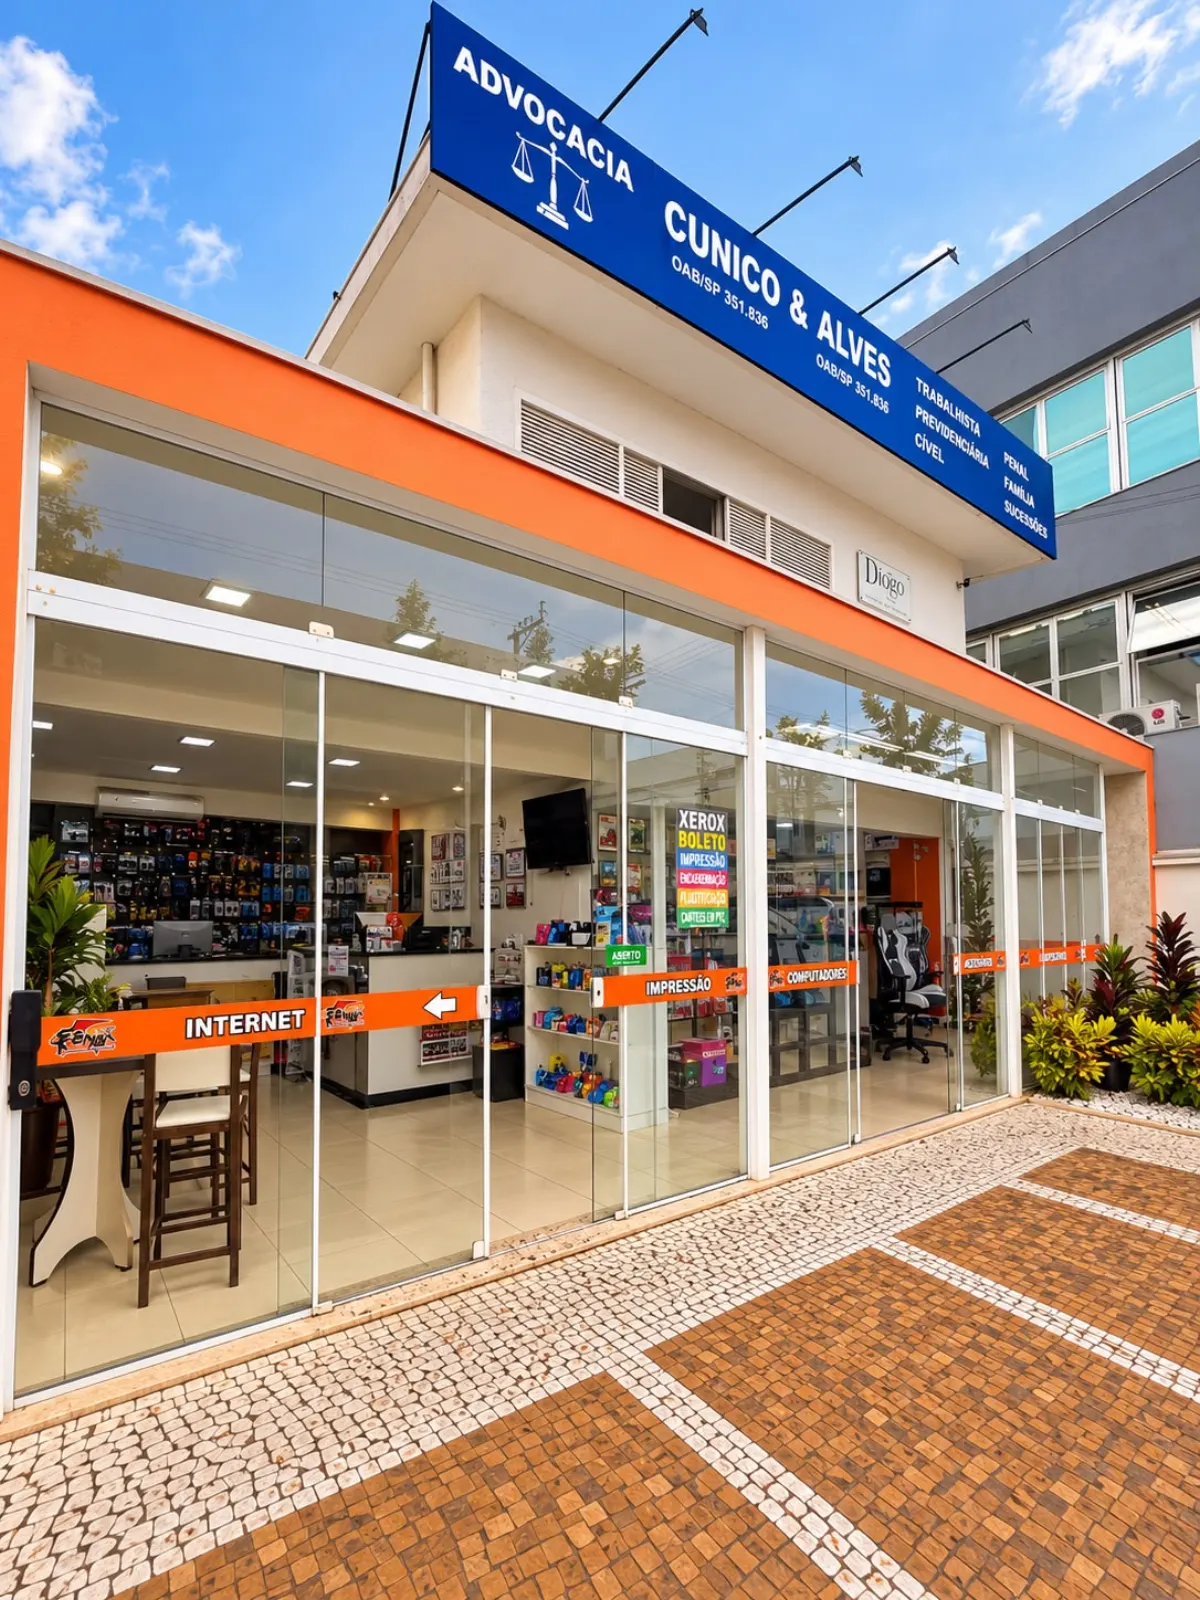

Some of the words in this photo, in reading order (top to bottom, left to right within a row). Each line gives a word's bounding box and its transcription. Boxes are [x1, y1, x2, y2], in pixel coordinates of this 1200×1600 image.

[453, 46, 634, 192] ADVOCACIA
[665, 201, 780, 306] CUNICO
[790, 289, 808, 330] &
[817, 310, 891, 387] ALVES
[672, 255, 720, 295] OAB/SP
[724, 290, 769, 329] 351.836
[816, 353, 853, 387] OAB/SP
[855, 381, 889, 414] 351.836
[916, 376, 980, 437] TRABALHISTA
[915, 432, 944, 464] CÍVEL
[916, 404, 990, 469] PREVIDENCIÁRIA
[1004, 452, 1029, 481] PENAL
[1004, 476, 1034, 509] FAMÍLIA
[1004, 500, 1047, 538] SUCESSÕES
[865, 557, 904, 599] Diogo
[679, 809, 725, 832] XEROX
[679, 830, 726, 851] BOLETO
[680, 852, 726, 868] IMPRESSÃO
[646, 975, 711, 996] IMPRESSÃO
[787, 968, 848, 984] COMPUTADORES
[185, 1009, 306, 1039] INTERNET
